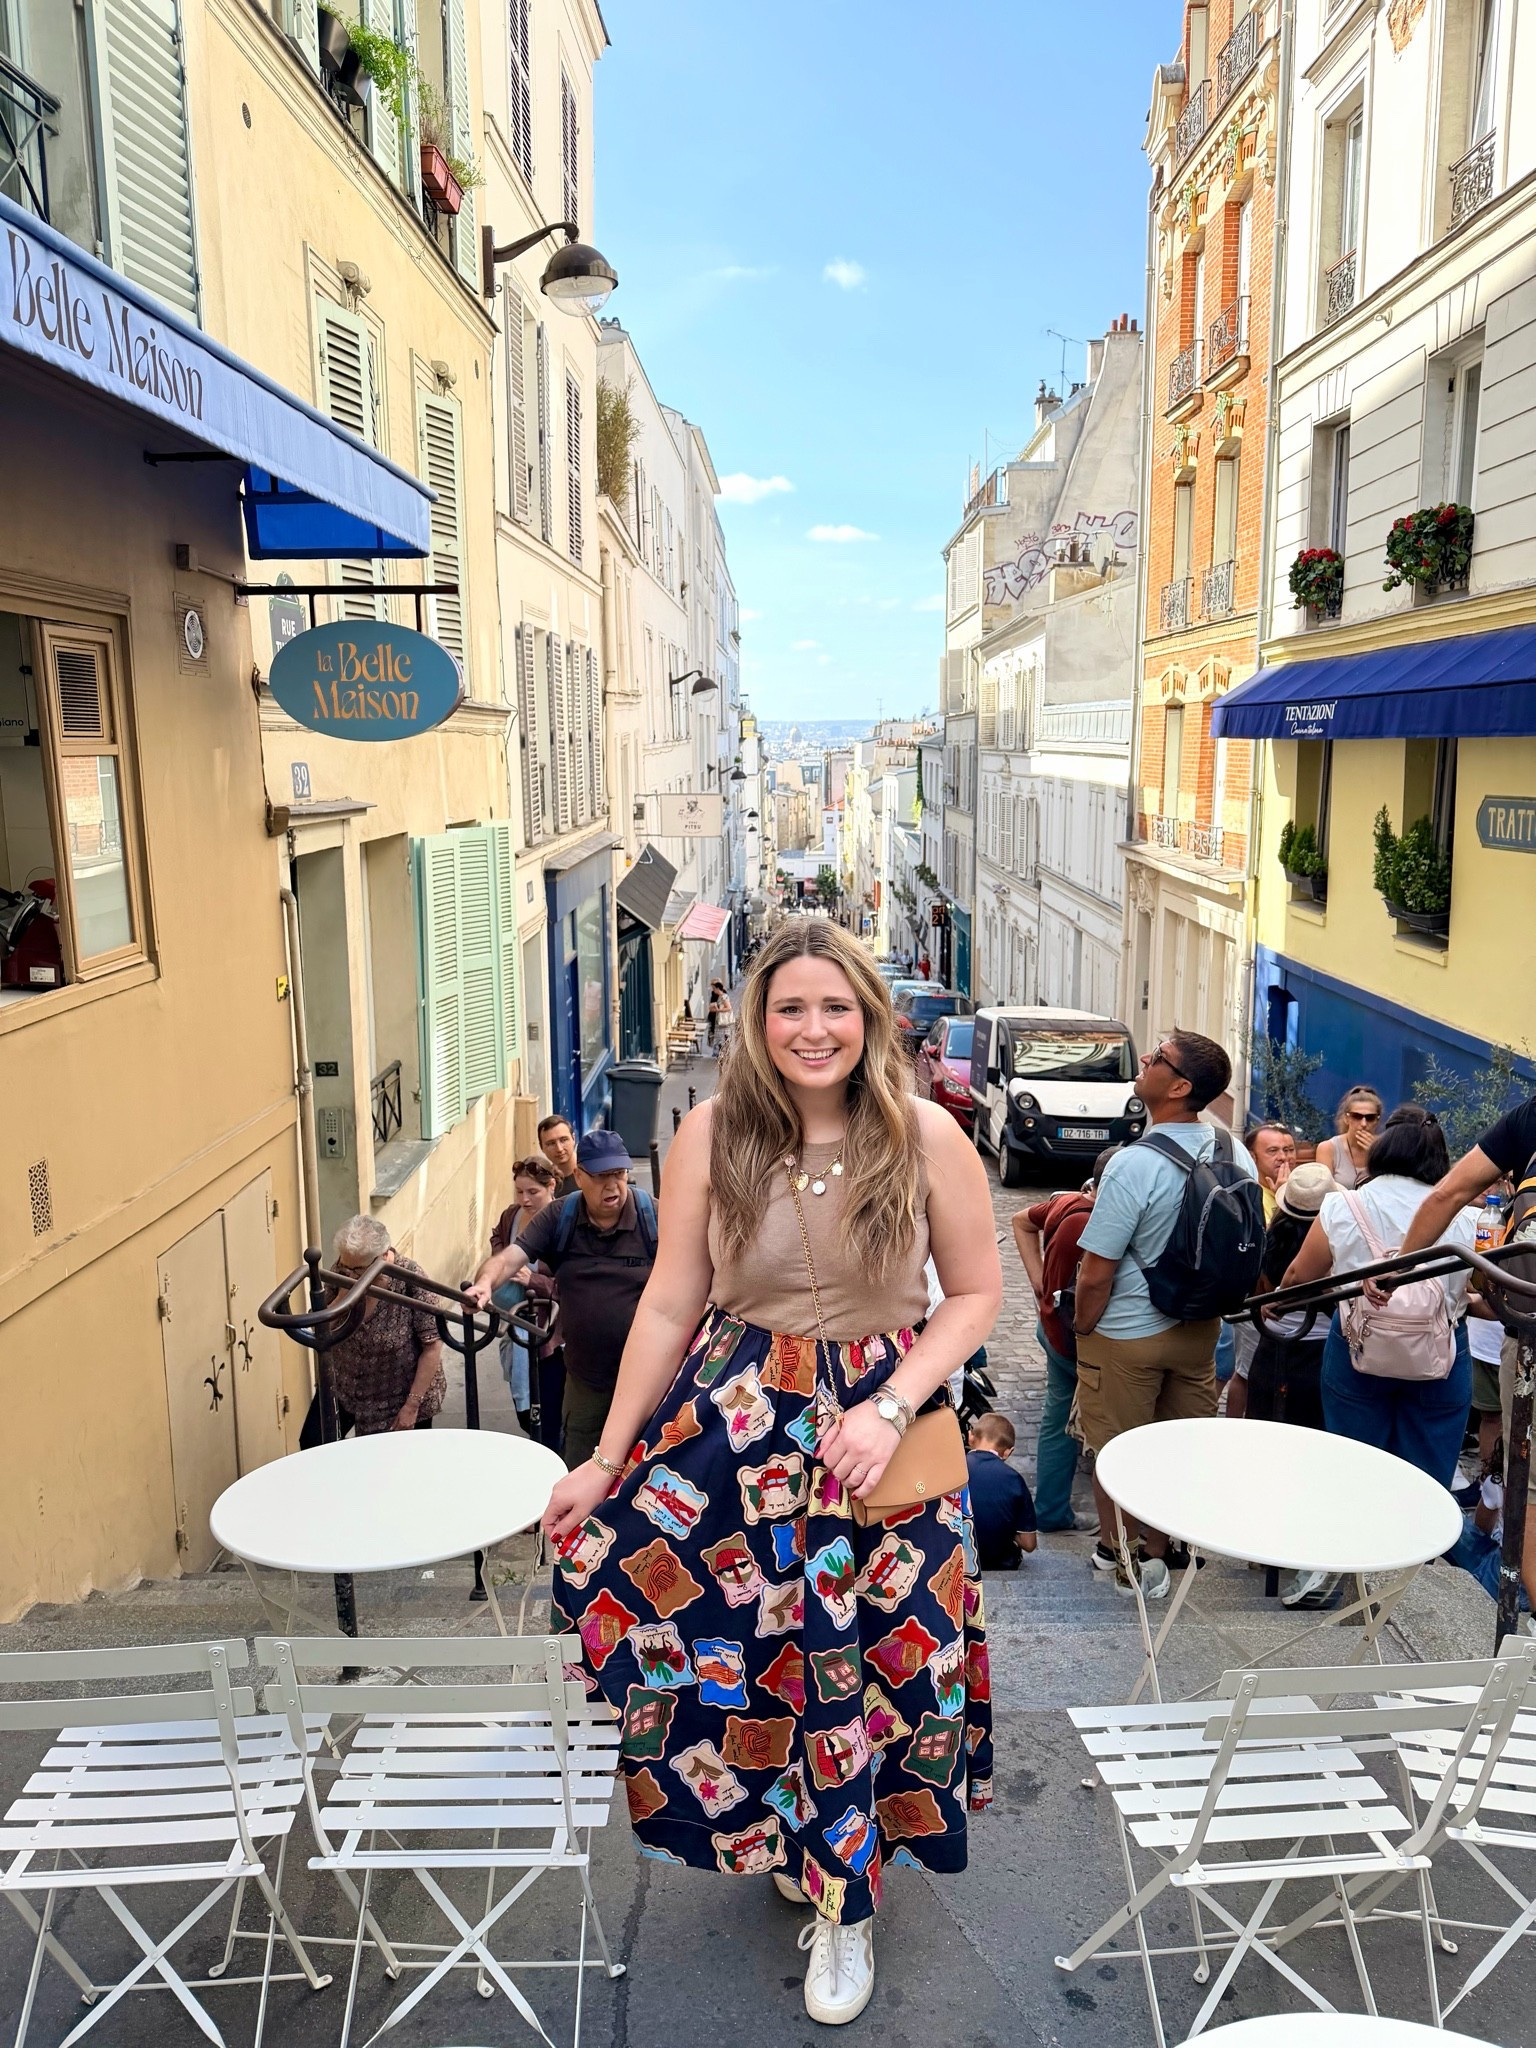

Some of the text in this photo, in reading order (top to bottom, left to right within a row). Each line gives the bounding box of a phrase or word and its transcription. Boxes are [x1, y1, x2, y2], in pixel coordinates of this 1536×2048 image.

[7, 228, 203, 421] Belle Maison
[281, 618, 297, 637] RUE
[316, 642, 414, 683] la Belle
[312, 680, 420, 720] Maison
[0, 717, 24, 728] iano
[294, 765, 310, 796] 32
[1488, 807, 1536, 841] TRATT
[932, 914, 945, 925] 21
[318, 1063, 336, 1075] 32
